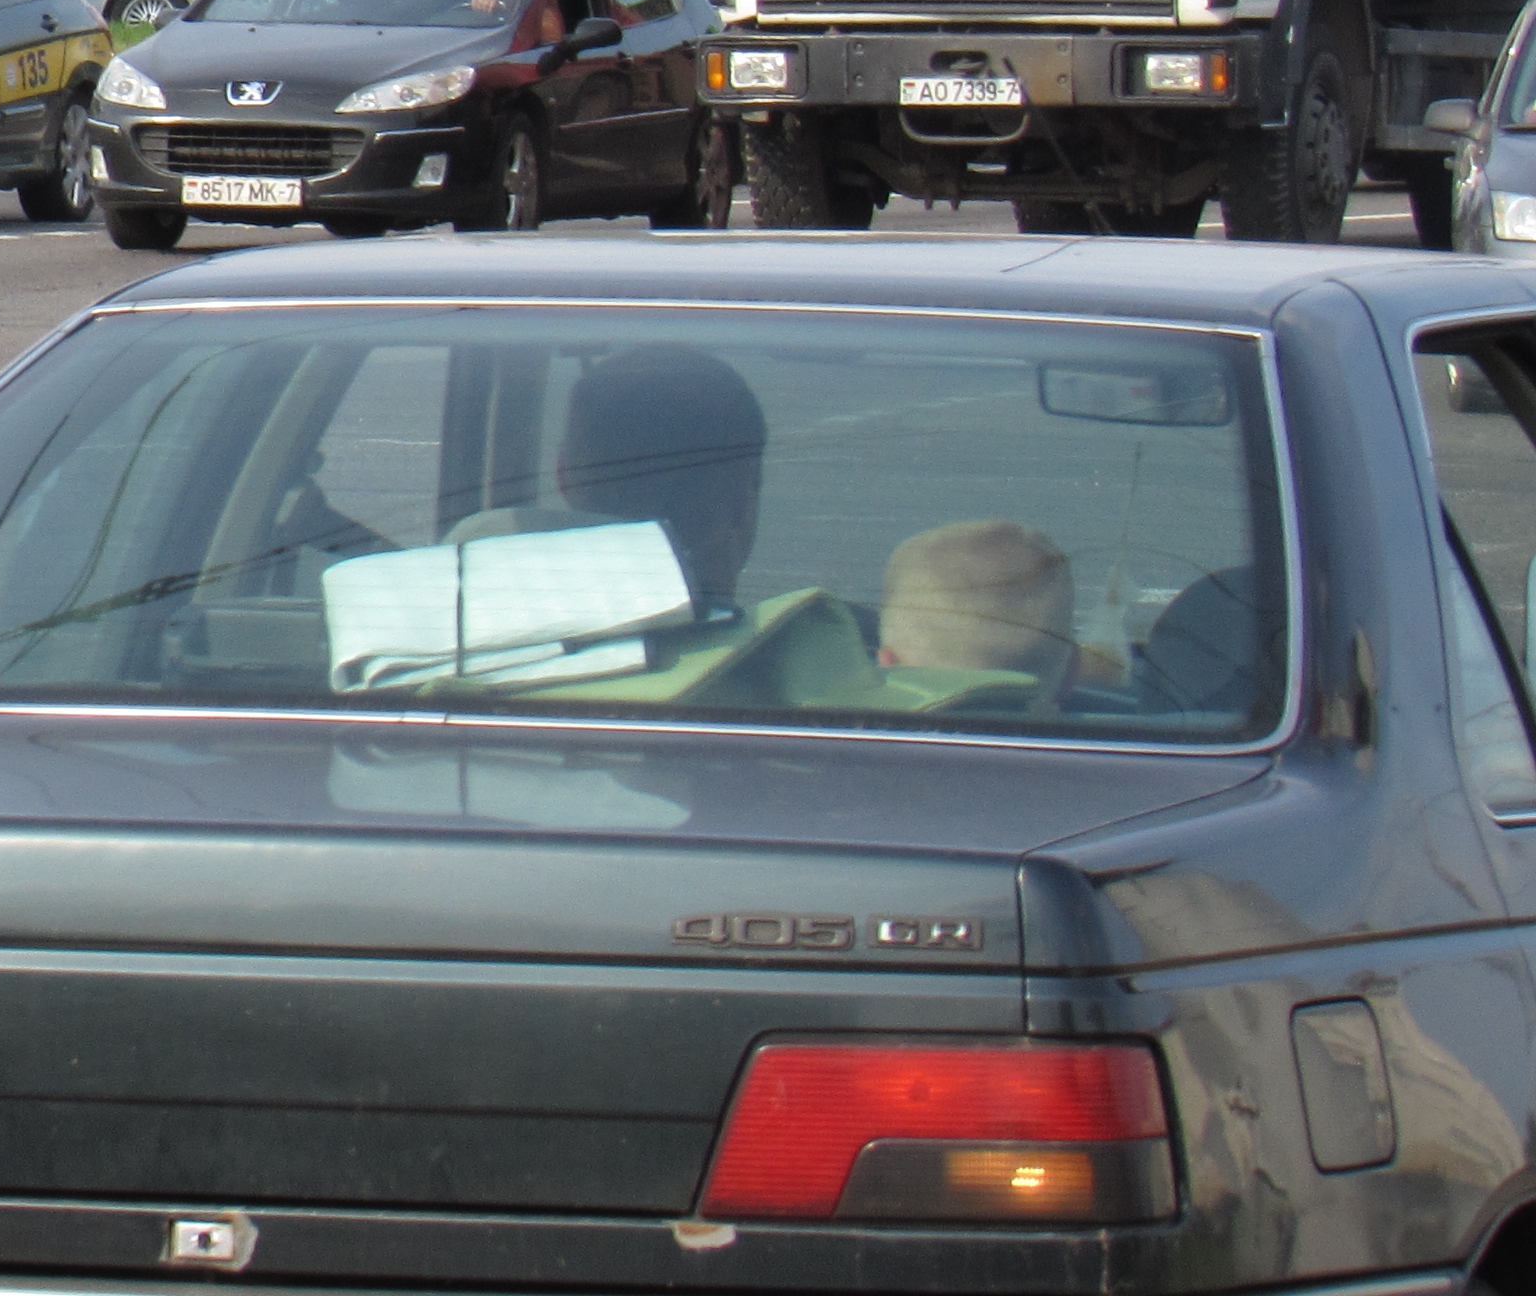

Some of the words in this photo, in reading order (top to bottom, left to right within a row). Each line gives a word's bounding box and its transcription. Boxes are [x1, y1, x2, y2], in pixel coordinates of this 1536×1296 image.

[18, 49, 49, 91] 135
[953, 81, 1017, 102] 7339-7
[201, 182, 244, 201] 8517
[248, 183, 299, 202] MK-7
[672, 910, 856, 951] 405
